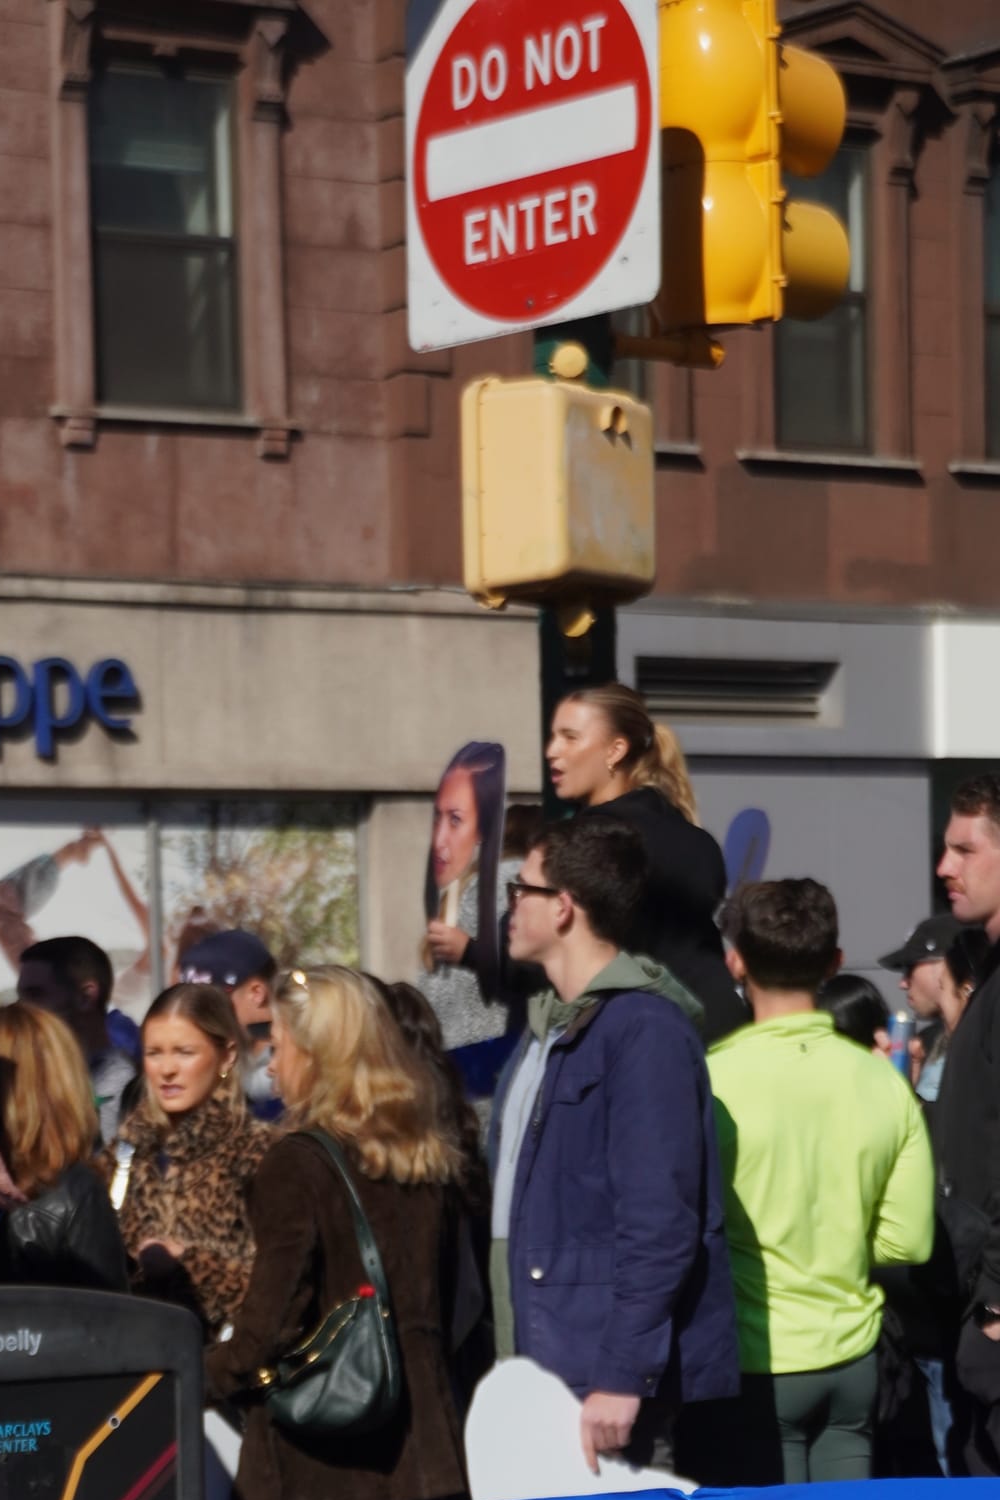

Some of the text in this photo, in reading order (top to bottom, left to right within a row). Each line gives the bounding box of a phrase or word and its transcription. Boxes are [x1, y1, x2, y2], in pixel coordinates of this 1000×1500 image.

[451, 17, 607, 111] DO NOT
[463, 184, 598, 266] ENTER
